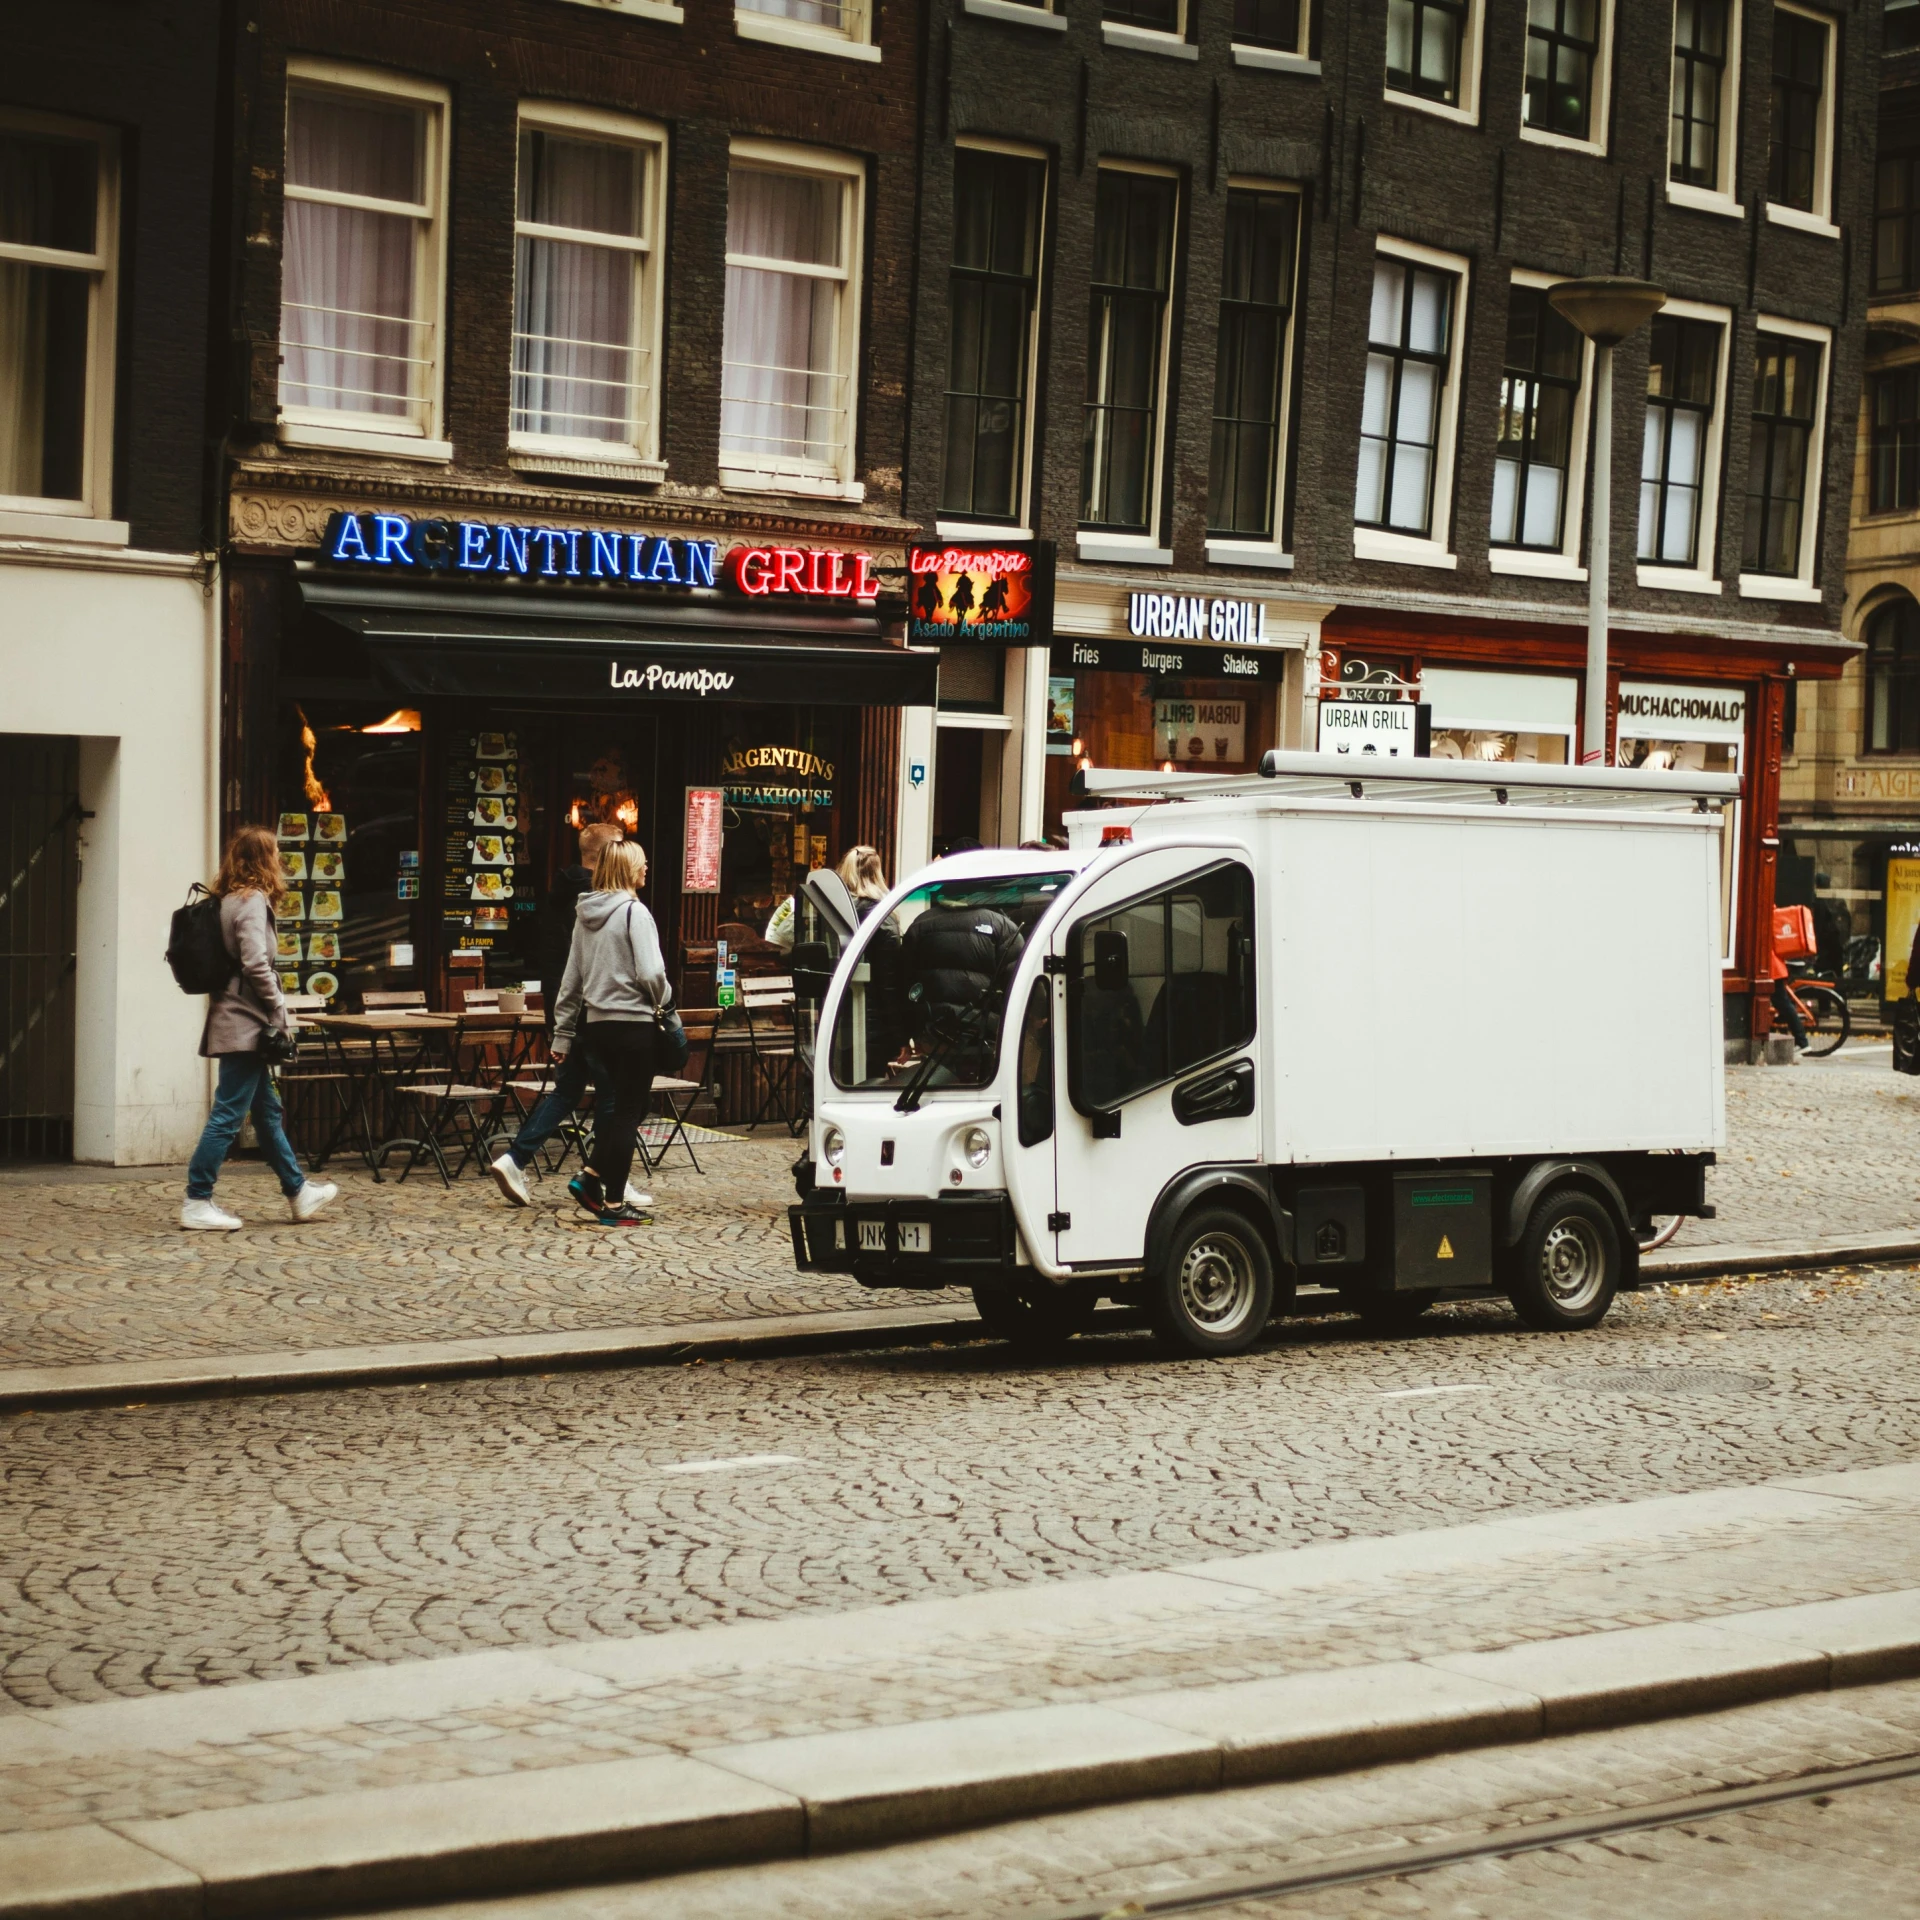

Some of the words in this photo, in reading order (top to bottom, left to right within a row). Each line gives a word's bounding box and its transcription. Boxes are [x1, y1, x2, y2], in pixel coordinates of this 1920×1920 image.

[332, 514, 717, 587] ARGENTINIAN
[736, 547, 881, 598] GRILL
[910, 549, 943, 574] La
[943, 550, 1027, 582] Pampa
[912, 617, 956, 638] Asado
[959, 617, 1031, 641] Argentino
[1129, 592, 1206, 641] URBAN
[1209, 598, 1271, 645] GRILL
[1072, 643, 1099, 665] Fries
[1141, 648, 1183, 674] Burgers
[1222, 653, 1259, 675] Shakes
[610, 661, 644, 690] La
[645, 665, 734, 696] Pampa
[1326, 708, 1368, 729] URBAN
[1372, 709, 1408, 731] GRILL
[722, 747, 835, 781] ARGENTIJNS
[723, 786, 833, 806] STEAKHOUSE
[466, 937, 475, 946] LA
[475, 937, 494, 946] PAMPA
